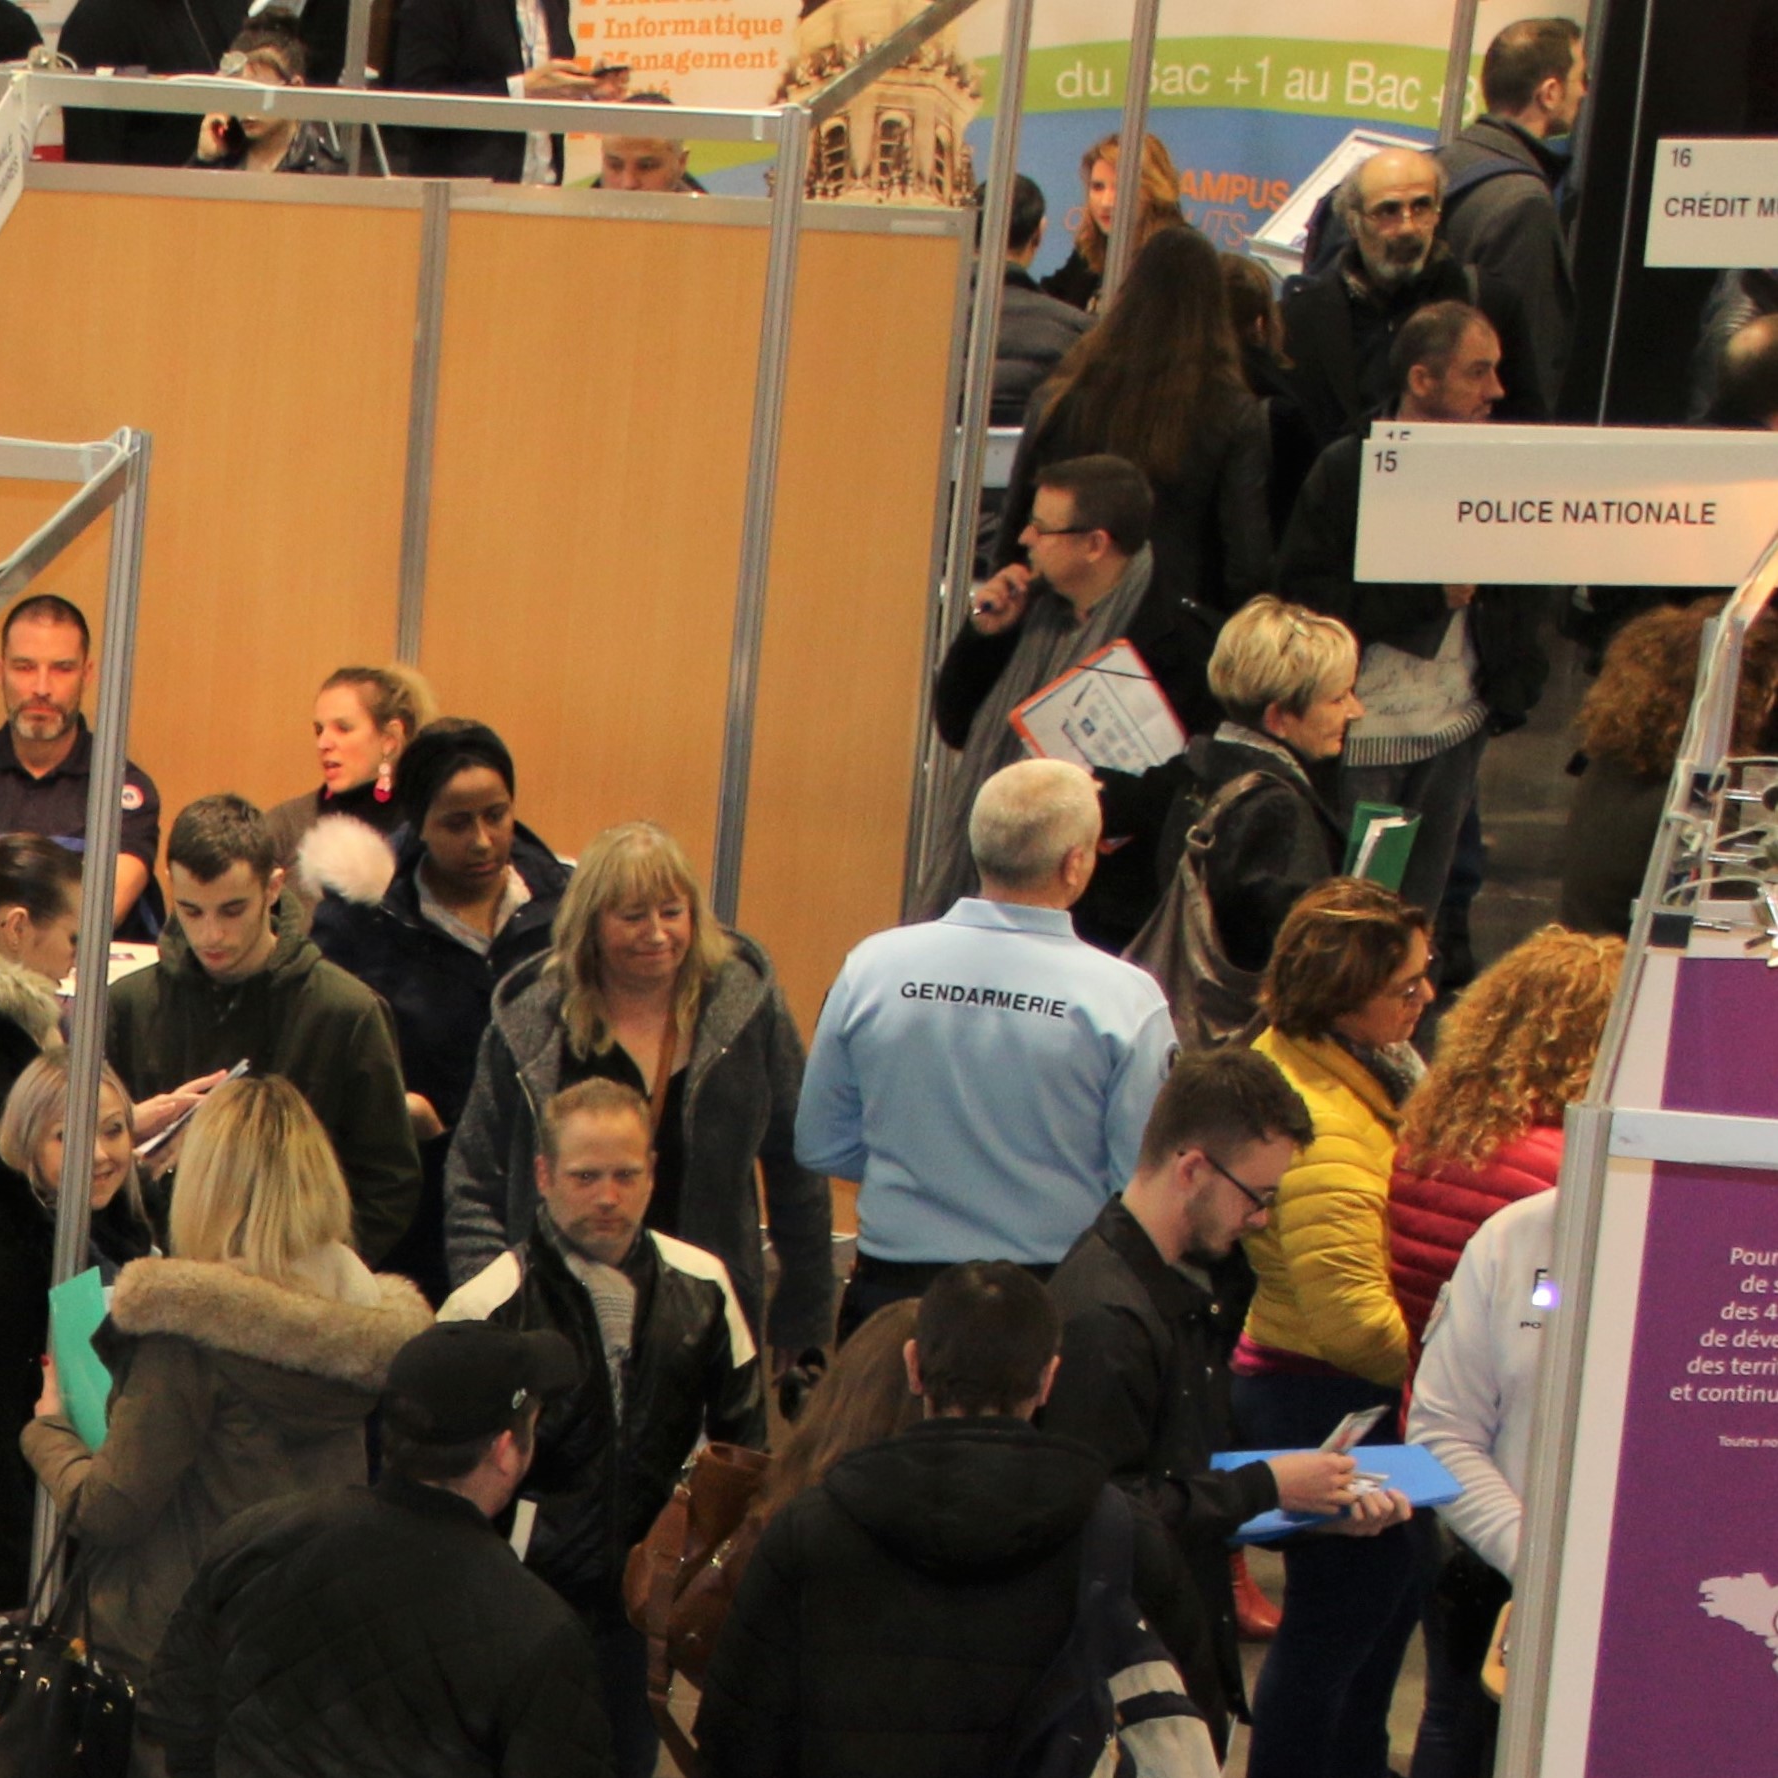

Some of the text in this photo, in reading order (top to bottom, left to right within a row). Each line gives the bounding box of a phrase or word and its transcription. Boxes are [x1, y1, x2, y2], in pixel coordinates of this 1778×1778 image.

[603, 13, 783, 39] Informatique
[1056, 60, 1112, 98] du
[1226, 56, 1272, 96] +1
[1284, 69, 1329, 102] au
[1346, 60, 1422, 111] Bac
[1671, 148, 1692, 168] 16
[1664, 192, 1752, 218] CRÉDIT
[1374, 451, 1398, 473] 15
[1457, 499, 1717, 526] POLICE NATIONALE
[901, 981, 1067, 1018] GENDARMERIE
[1729, 1246, 1778, 1266] Pour
[1740, 1274, 1768, 1294] de
[1720, 1301, 1759, 1321] des
[1699, 1328, 1727, 1348] de
[1686, 1356, 1724, 1376] des
[1669, 1383, 1692, 1402] et
